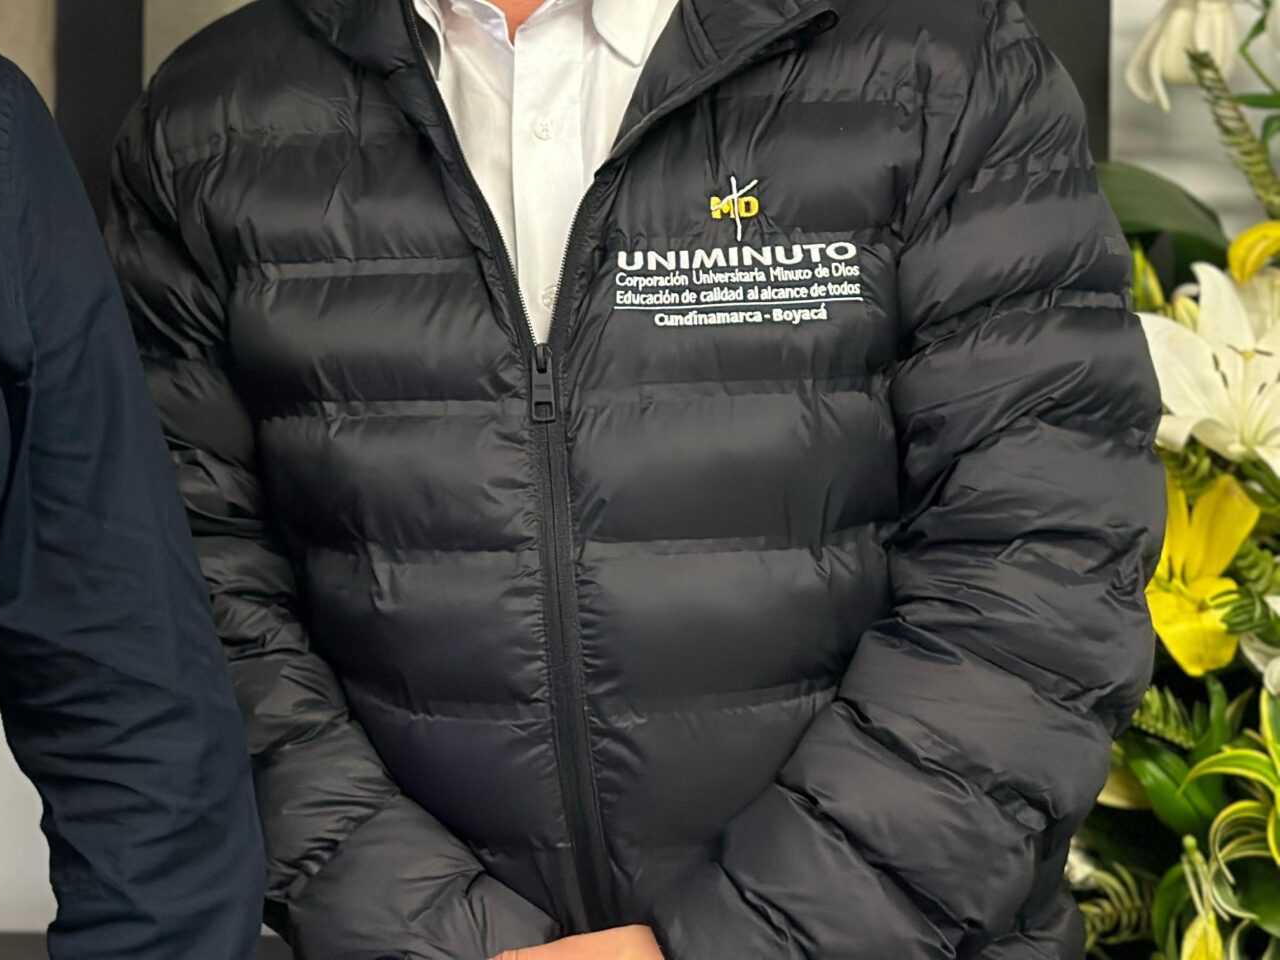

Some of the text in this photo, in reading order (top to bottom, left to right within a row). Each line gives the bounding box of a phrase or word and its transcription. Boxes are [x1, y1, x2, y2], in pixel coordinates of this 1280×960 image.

[617, 241, 857, 271] UNIMINUTO
[615, 262, 860, 290] Corporación Universitaria Minuto de Dios
[616, 280, 861, 305] Educación de calidad al alcance de todos
[654, 309, 762, 326] Cundinamarca
[772, 304, 828, 325] Boyacá
